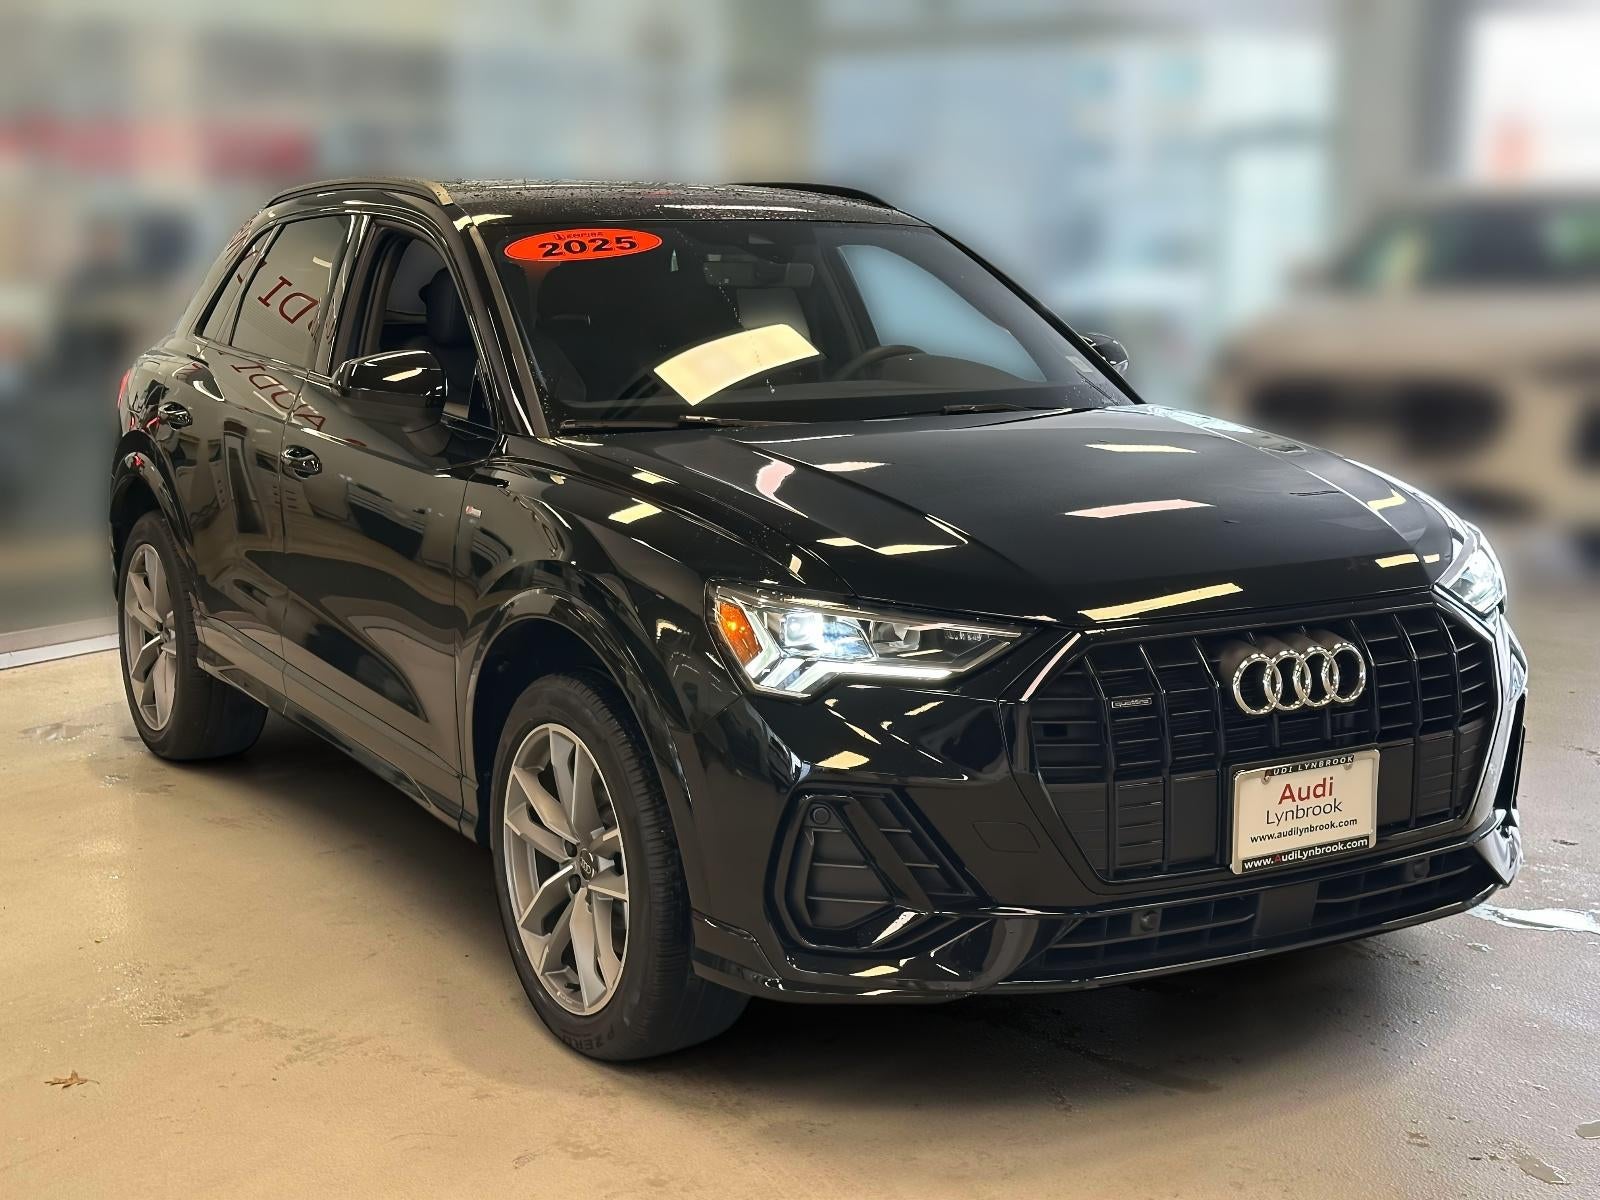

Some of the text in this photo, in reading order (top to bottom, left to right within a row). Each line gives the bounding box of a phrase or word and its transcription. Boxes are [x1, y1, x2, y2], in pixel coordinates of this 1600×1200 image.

[538, 235, 638, 258] 2025
[1298, 755, 1354, 771] LYNBROOK
[1278, 776, 1334, 805] Audi
[1266, 798, 1343, 826] Lynbrook
[1250, 818, 1358, 843] www.audilynbrook.com
[1244, 838, 1368, 869] www.AudiLynbrook.com
